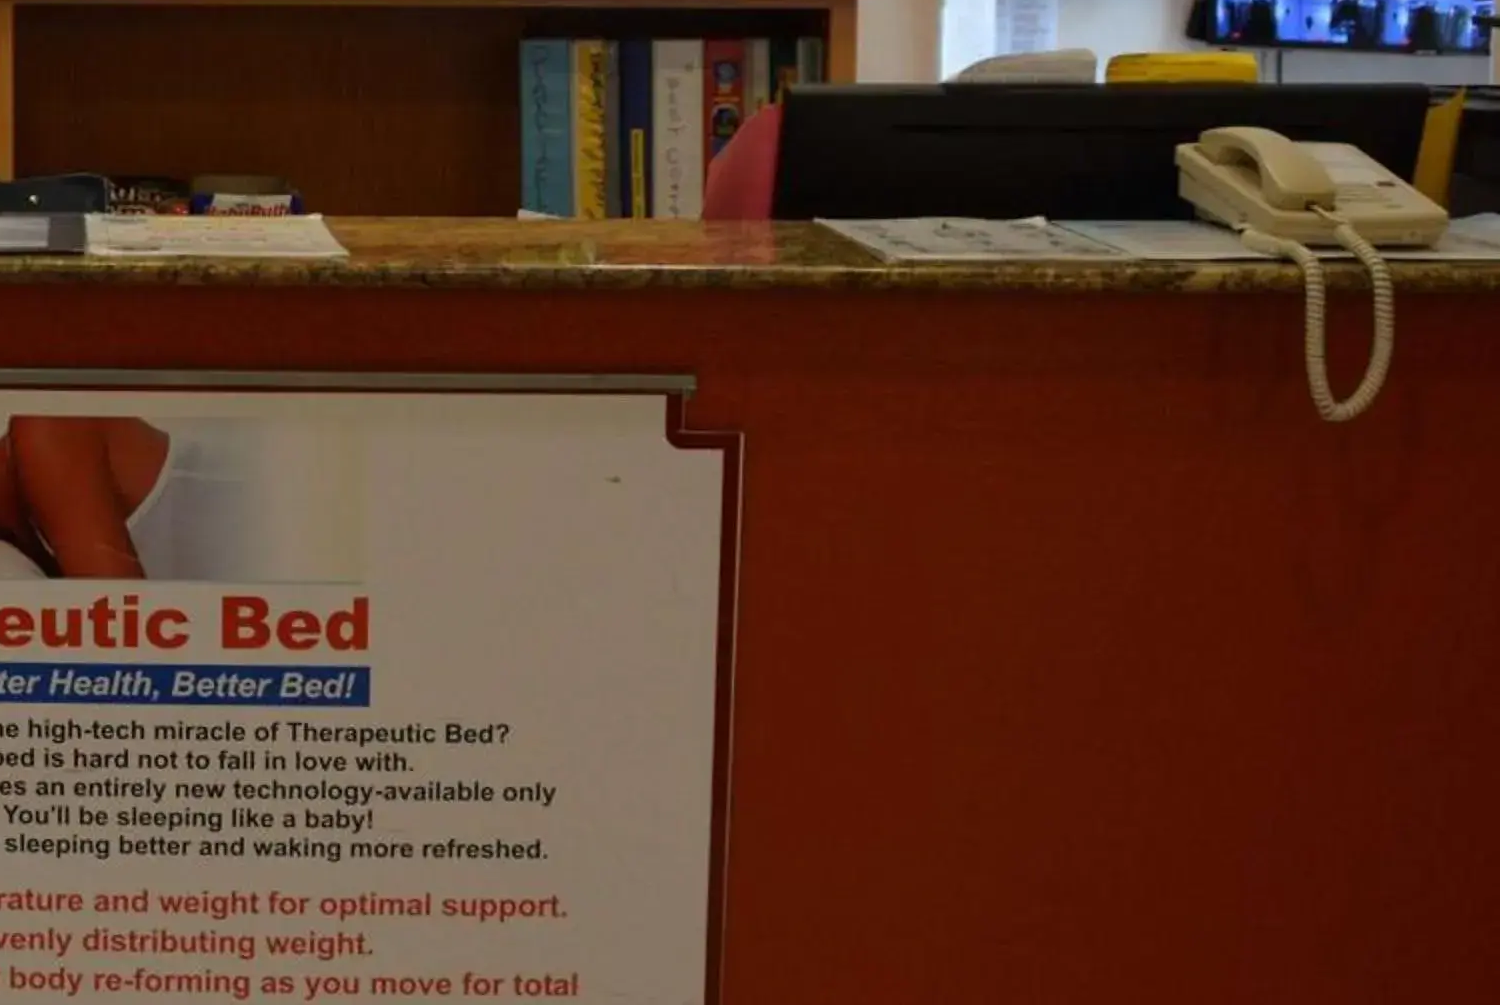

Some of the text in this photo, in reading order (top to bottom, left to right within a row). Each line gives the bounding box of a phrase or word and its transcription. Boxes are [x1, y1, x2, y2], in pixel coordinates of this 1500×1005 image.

[221, 596, 370, 651] Bed
[49, 670, 158, 698] Health,
[171, 671, 271, 697] Better
[280, 672, 355, 698] Bed!
[27, 718, 145, 744] high-tech
[154, 720, 246, 742] miracle
[254, 721, 280, 743] of
[286, 721, 437, 748] Therapeutic
[445, 723, 510, 745] Bed?
[43, 747, 65, 769] is
[73, 748, 129, 769] hard
[138, 751, 178, 770] not
[185, 750, 211, 770] to
[217, 749, 255, 771] fall
[264, 750, 287, 771] in
[295, 750, 347, 772] love
[355, 751, 414, 772] with.
[35, 780, 65, 797] an
[73, 777, 167, 804] entirely
[175, 783, 226, 799] new
[232, 778, 495, 806] technology-available
[502, 782, 557, 807] only
[3, 804, 70, 826] You'll
[79, 805, 109, 826] be
[116, 806, 223, 833] sleeping
[231, 807, 275, 828] like
[282, 813, 296, 828] a
[305, 808, 373, 835] baby!
[4, 833, 110, 860] sleeping
[119, 834, 192, 856] better
[198, 836, 245, 857] and
[253, 836, 341, 863] waking
[350, 842, 414, 859] more
[422, 838, 548, 860] refreshed.
[93, 889, 149, 913] and
[158, 890, 260, 920] weight
[268, 890, 311, 916] for
[319, 892, 431, 922] optimal
[441, 895, 567, 923] support.
[82, 928, 255, 961] distributing
[265, 931, 373, 961] weight.
[9, 966, 83, 997] body
[93, 968, 251, 999] re-forming
[260, 976, 295, 994] as
[305, 976, 360, 1000] you
[371, 976, 452, 996] move
[462, 971, 505, 996] for
[513, 972, 579, 997] total
